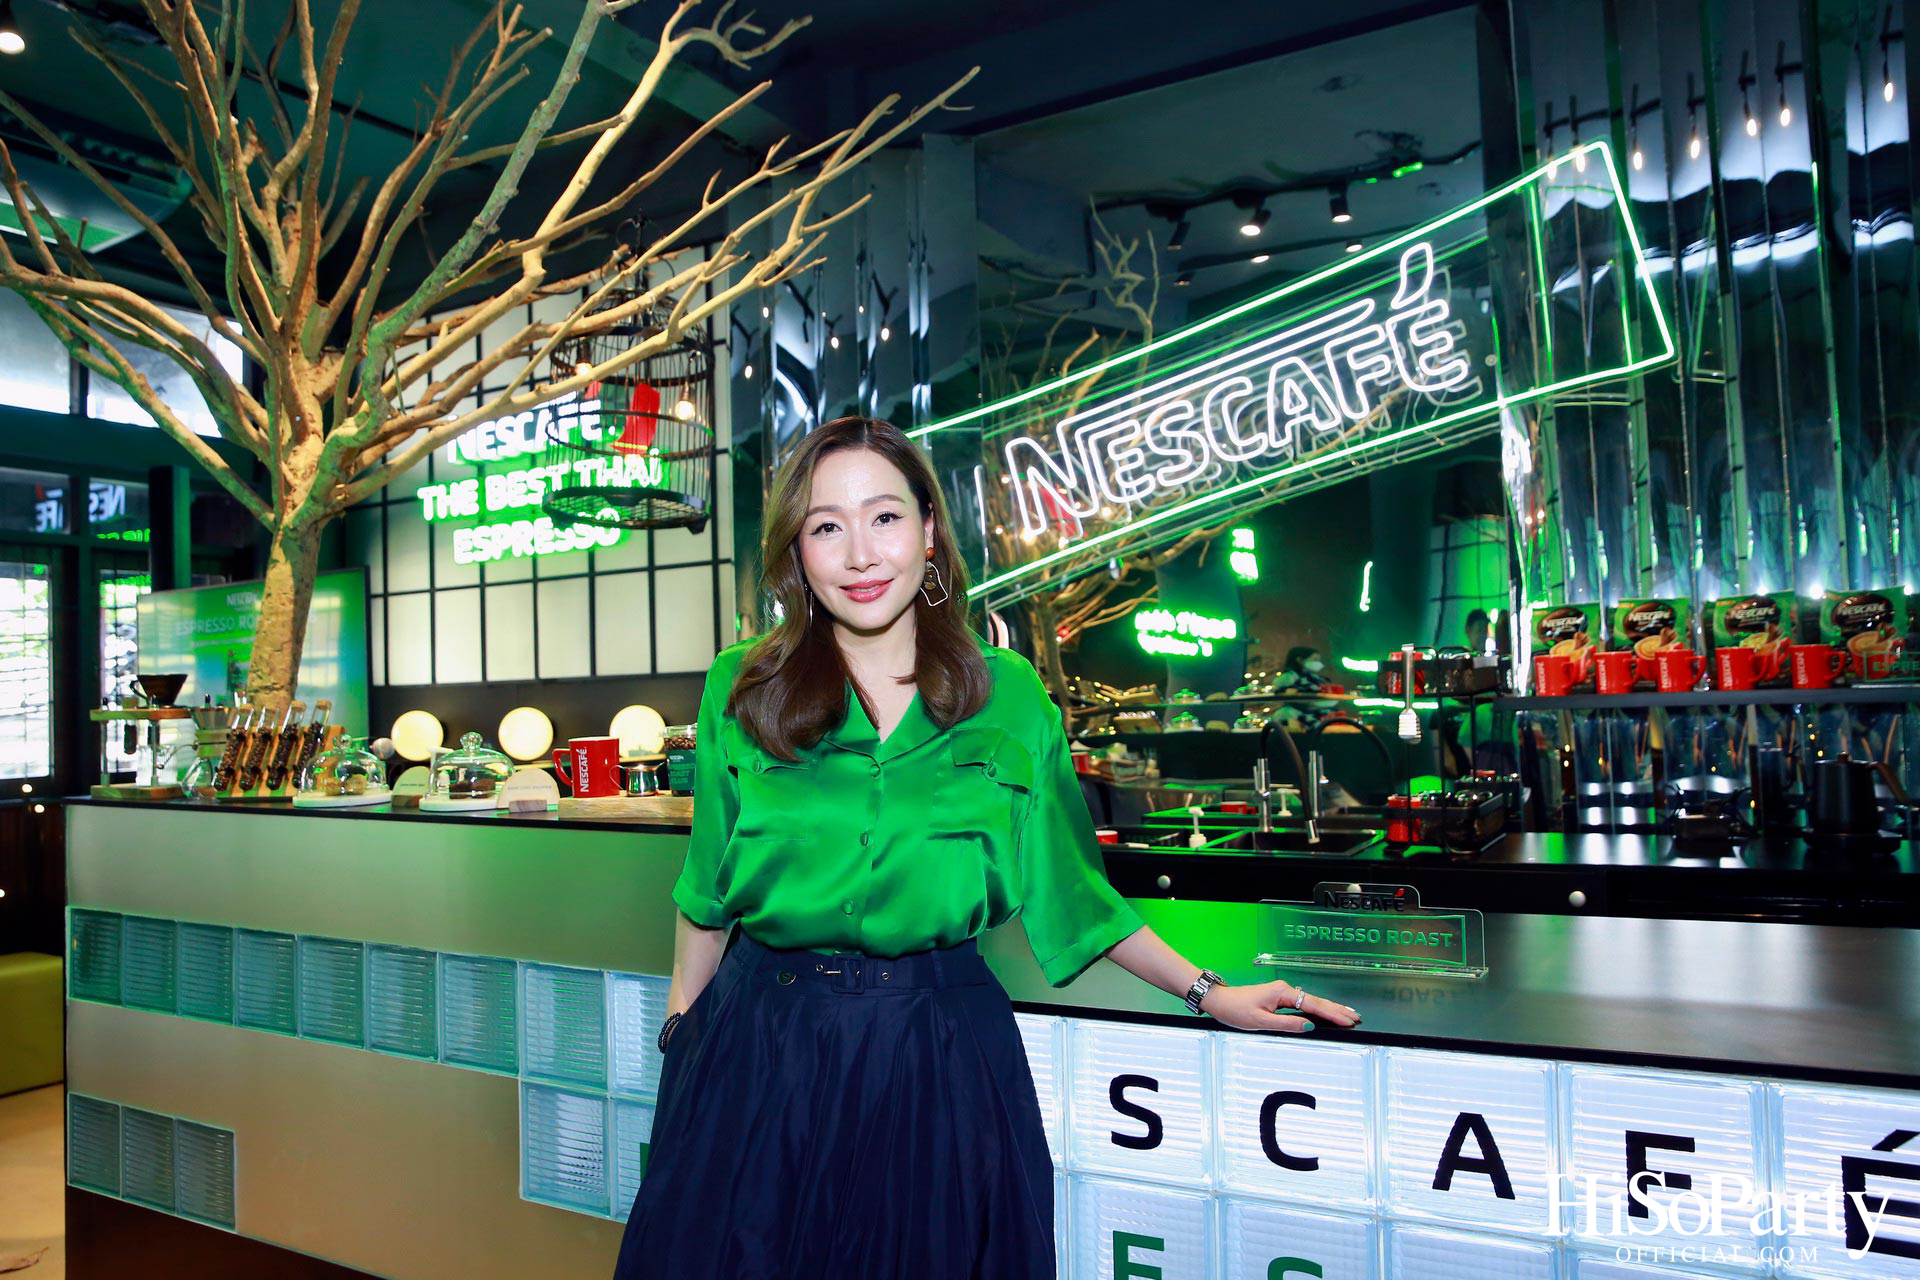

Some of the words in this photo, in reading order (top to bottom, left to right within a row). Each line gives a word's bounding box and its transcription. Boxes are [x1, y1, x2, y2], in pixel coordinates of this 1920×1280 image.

[1004, 242, 1469, 537] NESCAFÉ
[417, 479, 480, 521] THE
[485, 460, 569, 512] BEST
[1324, 888, 1406, 912] NESCAFÉ
[1284, 924, 1381, 944] ESPRESSO
[1386, 929, 1454, 948] ROAST
